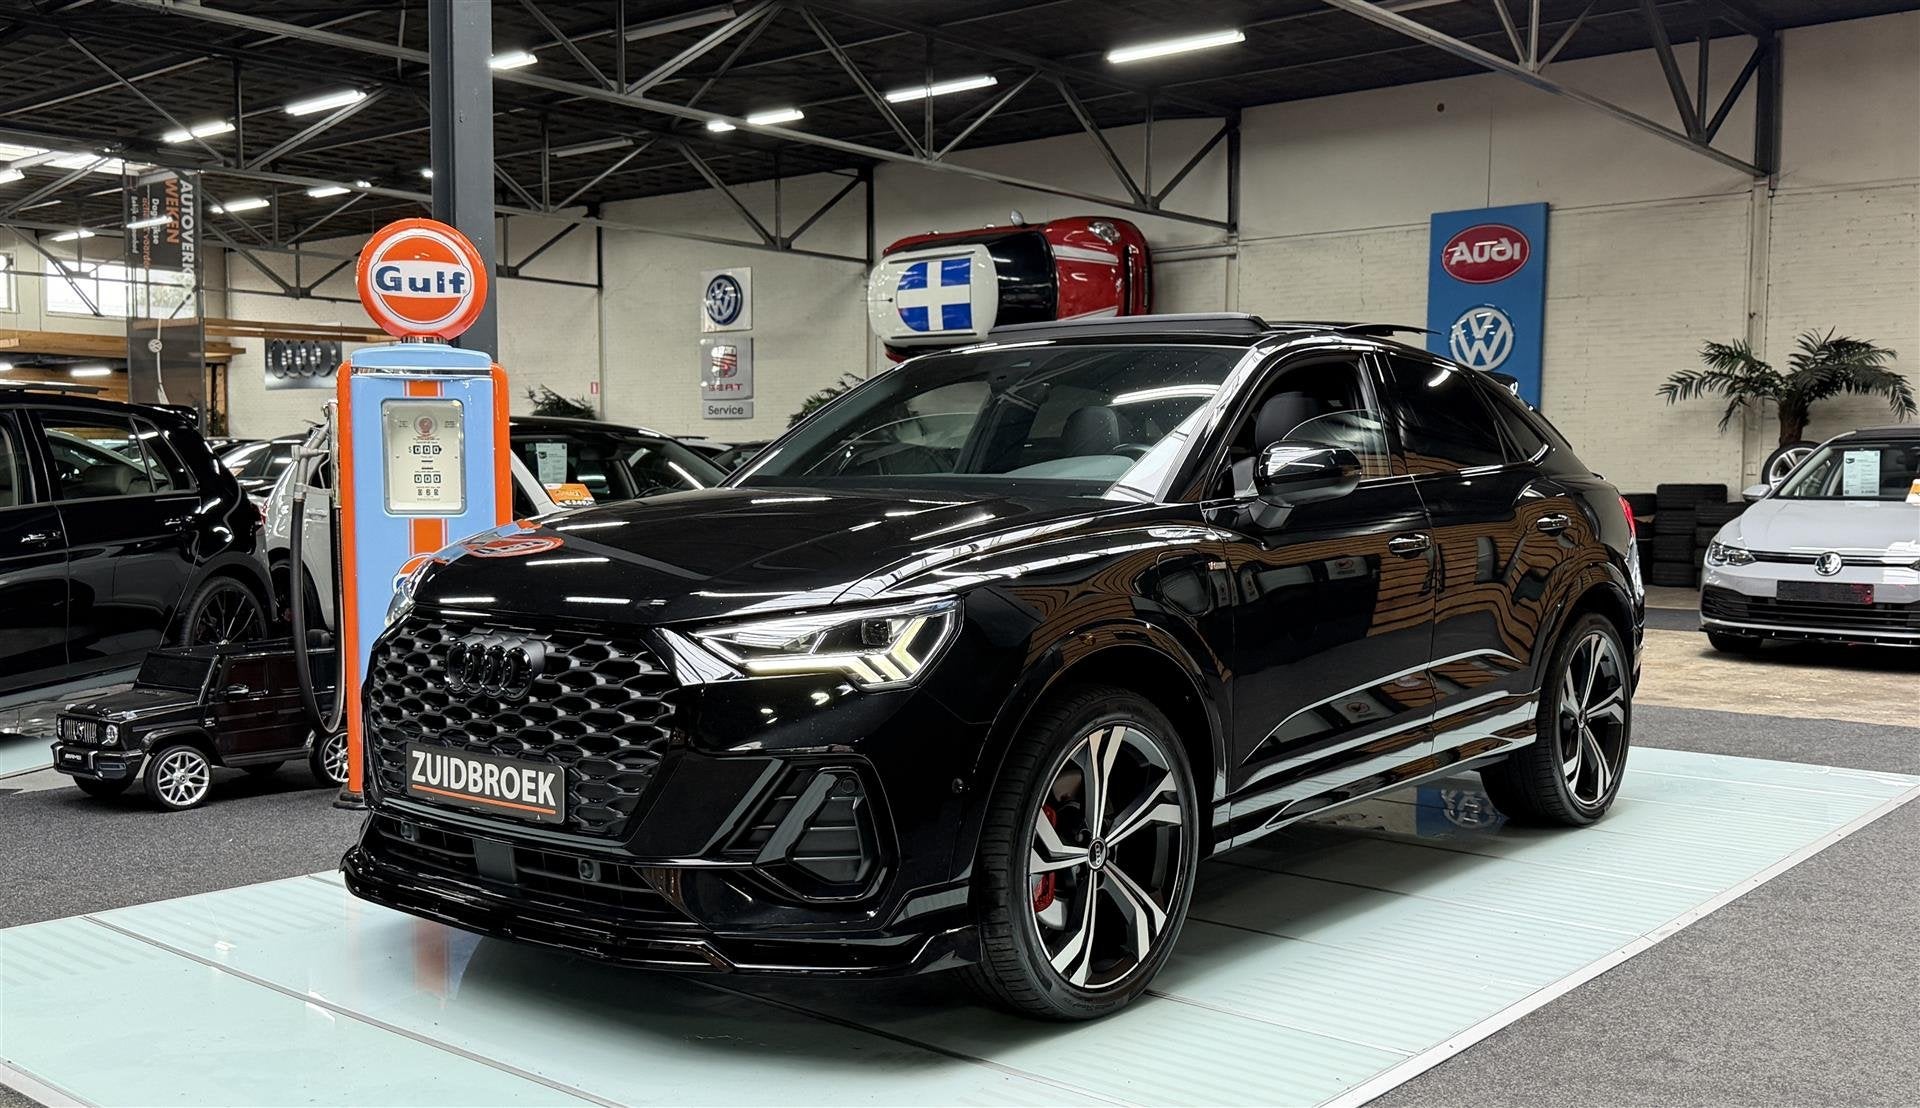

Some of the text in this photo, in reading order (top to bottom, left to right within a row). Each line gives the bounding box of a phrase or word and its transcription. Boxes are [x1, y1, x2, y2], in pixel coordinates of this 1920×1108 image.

[165, 178, 180, 244] WEKEN
[375, 265, 466, 294] Gulf
[708, 383, 743, 392] SEAT
[708, 404, 744, 415] Service
[411, 750, 556, 807] ZUIDBROEK
